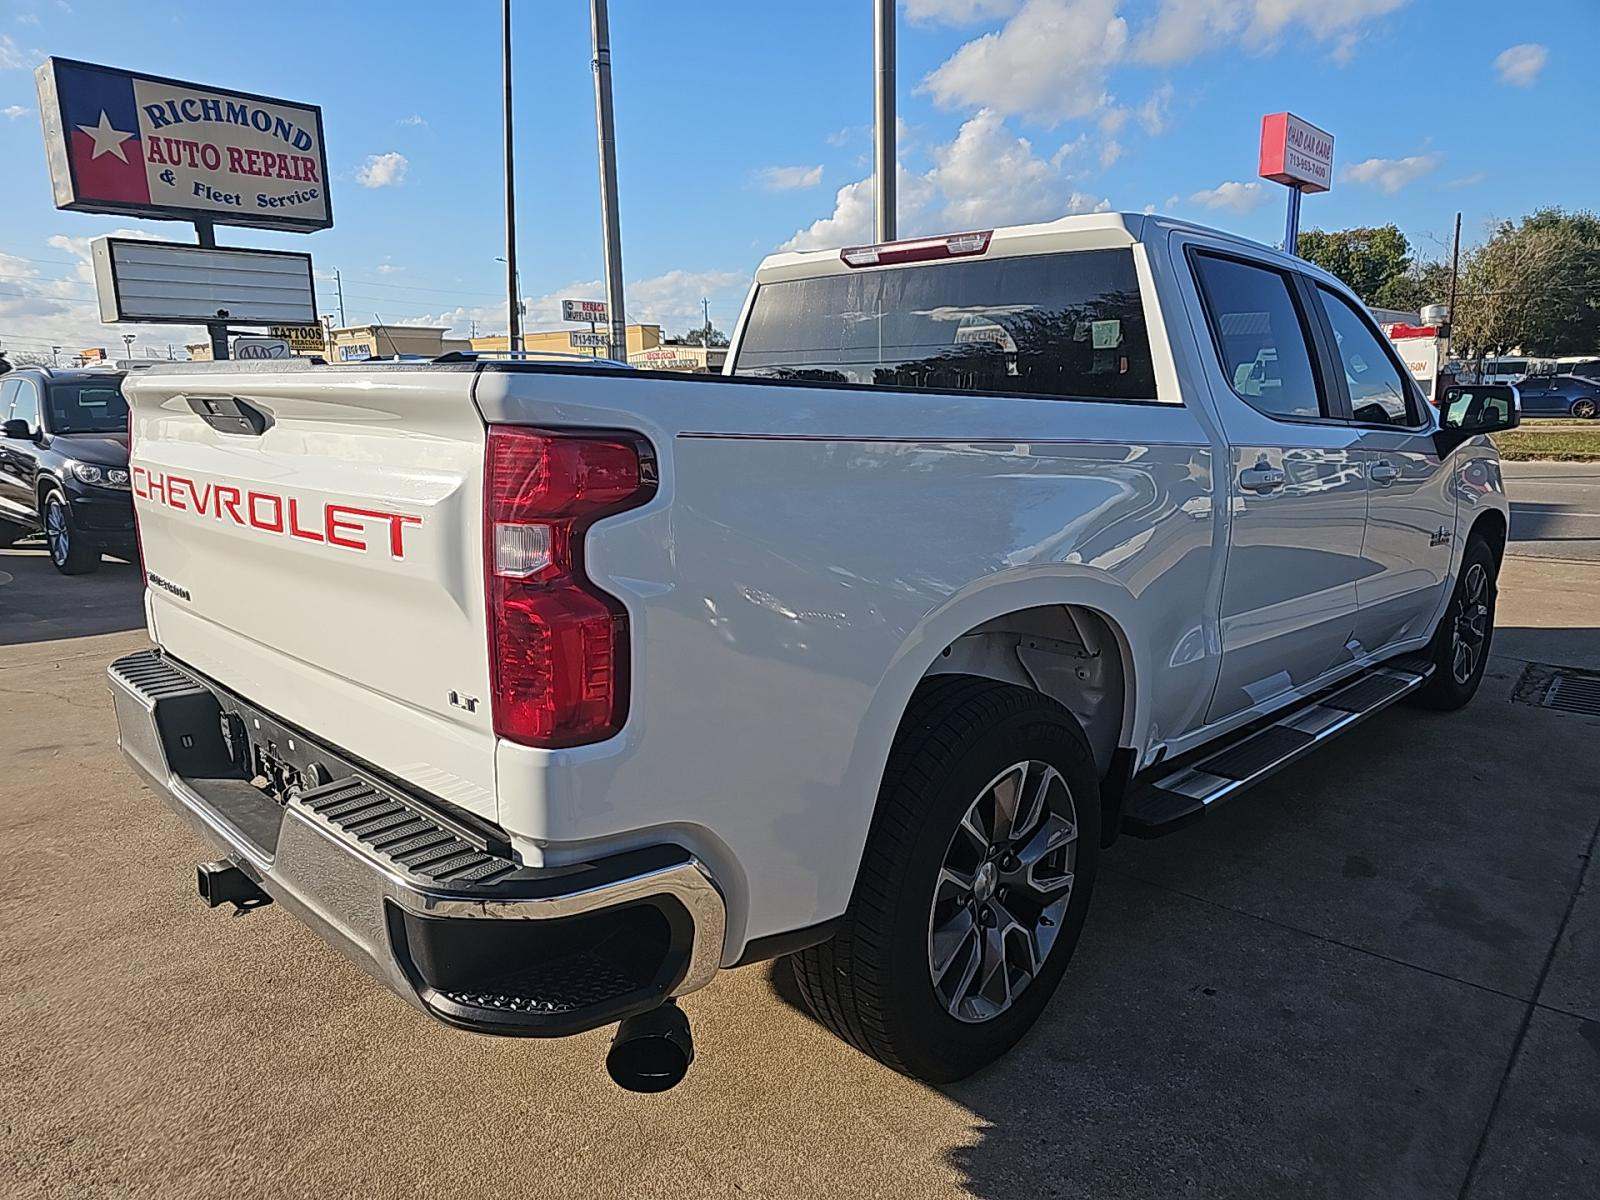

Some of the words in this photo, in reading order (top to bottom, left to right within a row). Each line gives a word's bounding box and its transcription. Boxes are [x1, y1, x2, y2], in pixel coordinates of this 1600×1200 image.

[142, 98, 313, 151] RICHMOND
[147, 135, 221, 171] AUTO
[226, 146, 320, 183] REPAIR
[159, 168, 177, 187] &
[192, 181, 242, 206] Fleet
[256, 187, 320, 208] Service
[272, 326, 321, 340] TATTOOS
[567, 311, 593, 321] MUFFLER
[132, 466, 422, 559] CHEVROLET
